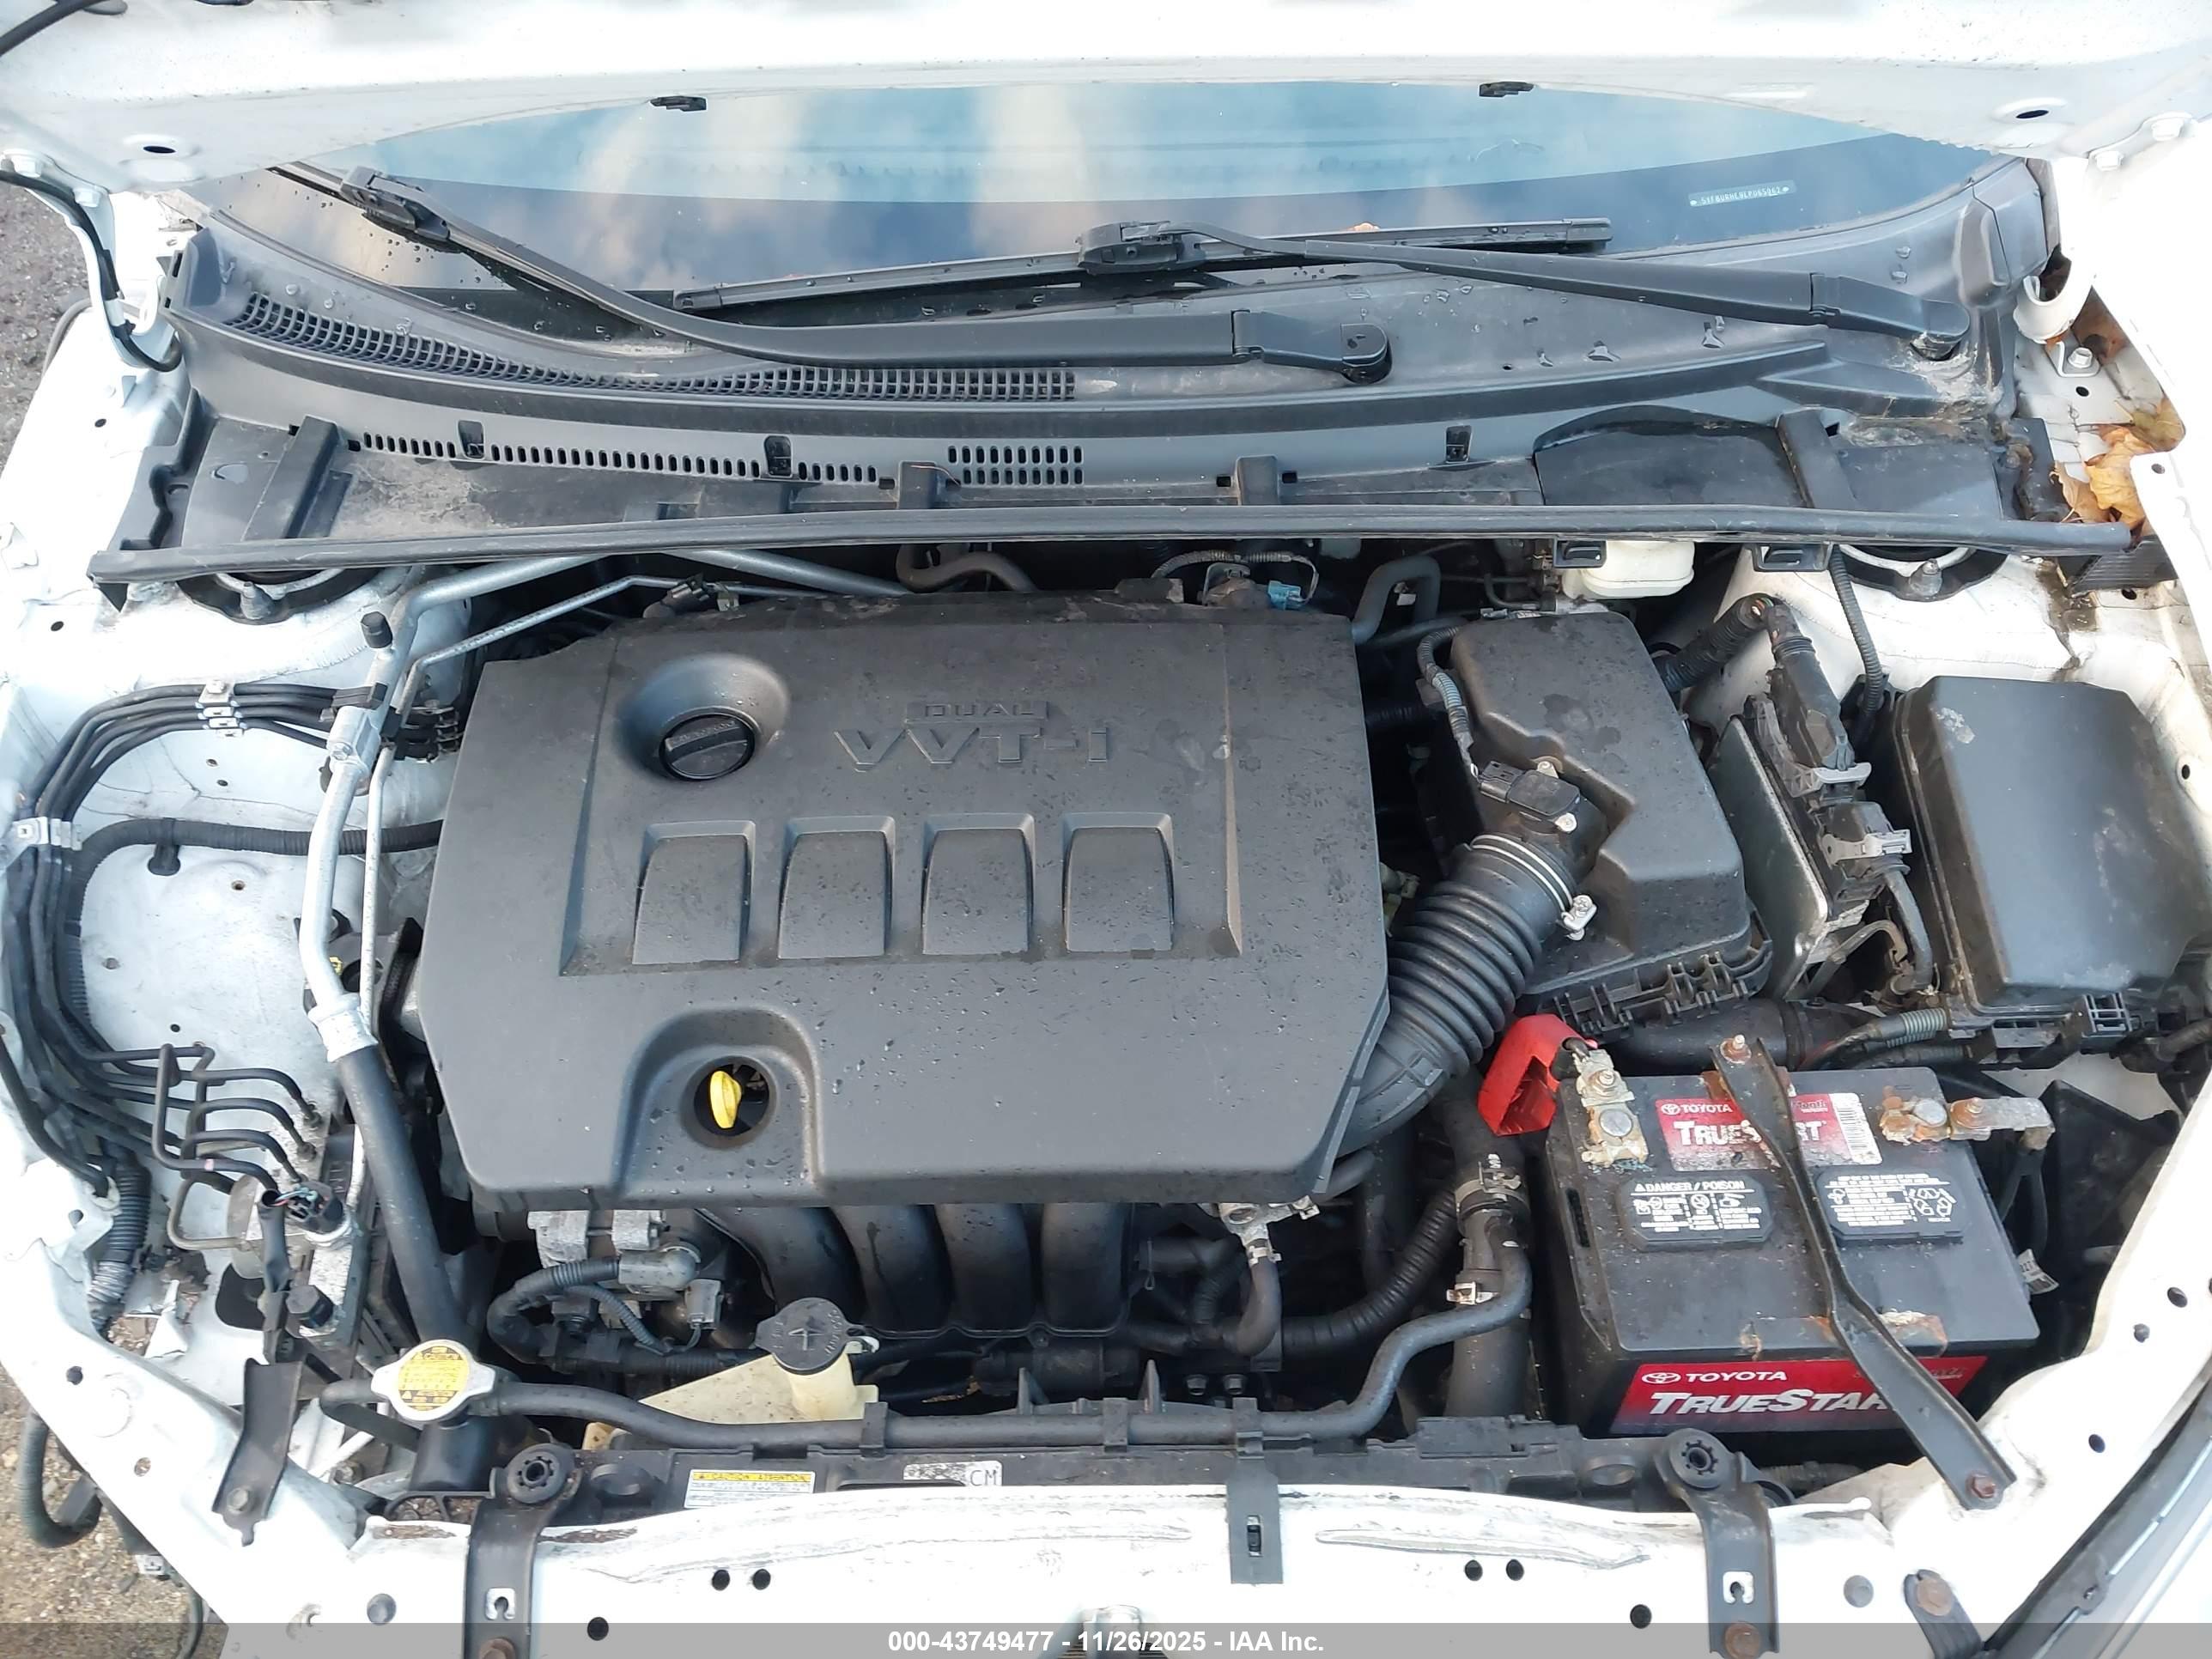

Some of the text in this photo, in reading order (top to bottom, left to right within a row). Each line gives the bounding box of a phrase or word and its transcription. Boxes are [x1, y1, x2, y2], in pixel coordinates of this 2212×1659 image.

[925, 702, 1036, 718] DUAL
[1680, 1103, 1733, 1115] TOYOTA
[1644, 1182, 1692, 1193] DANGER
[1702, 1180, 1746, 1191] POISON
[1686, 1370, 1788, 1383] TOYOTA
